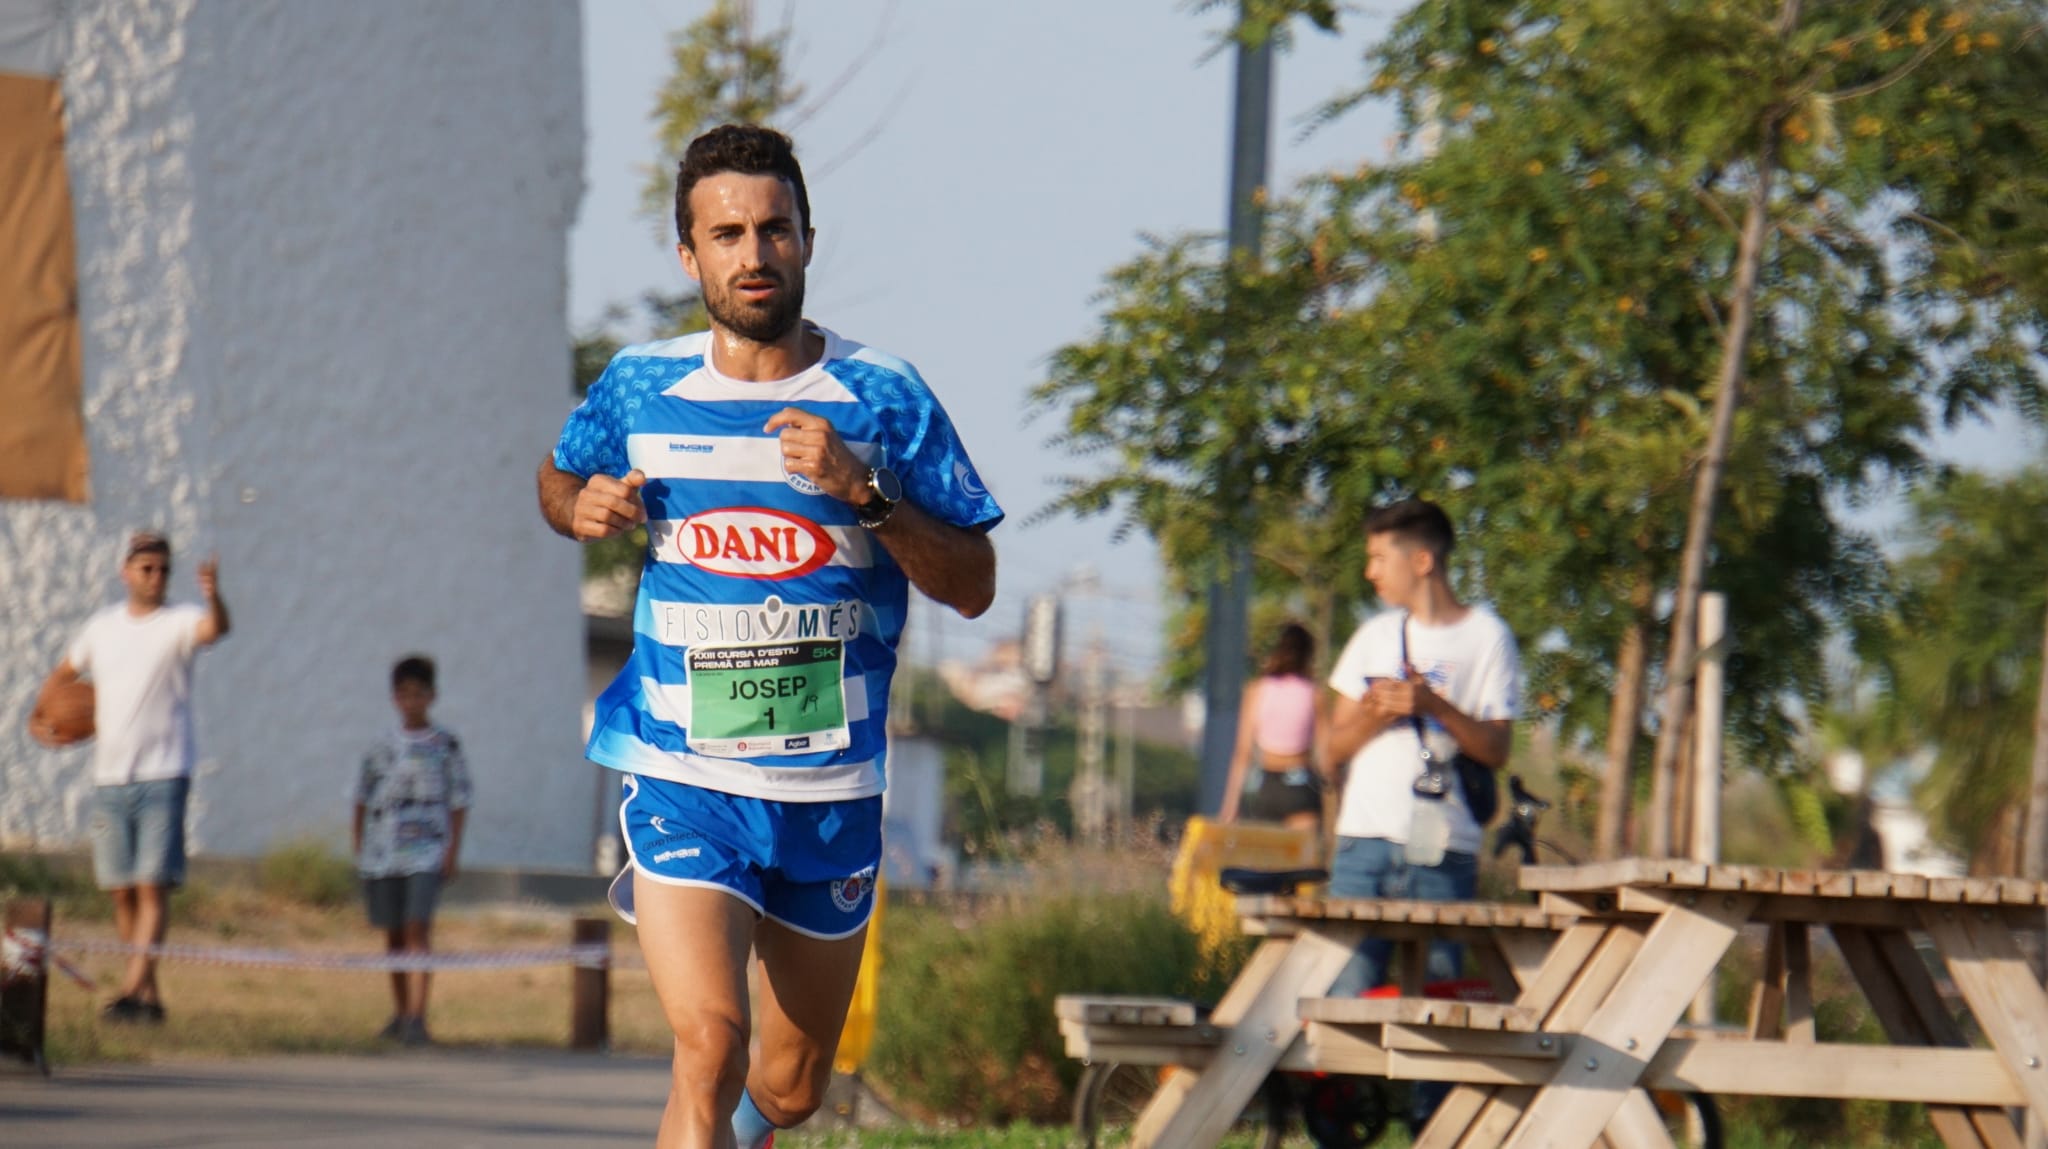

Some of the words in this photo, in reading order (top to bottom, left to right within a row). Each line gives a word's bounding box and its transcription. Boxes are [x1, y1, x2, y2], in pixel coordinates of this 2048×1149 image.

[790, 476, 820, 491] ESPAN
[691, 524, 799, 563] DANI
[665, 607, 750, 642] FISIO
[798, 601, 857, 638] MÉS
[717, 650, 754, 659] CURSA
[757, 646, 799, 657] D'ESTIU
[813, 648, 836, 658] 5K
[736, 661, 751, 669] DE
[753, 658, 780, 667] MAR
[730, 676, 806, 699] JOSEP
[763, 707, 774, 729] 1
